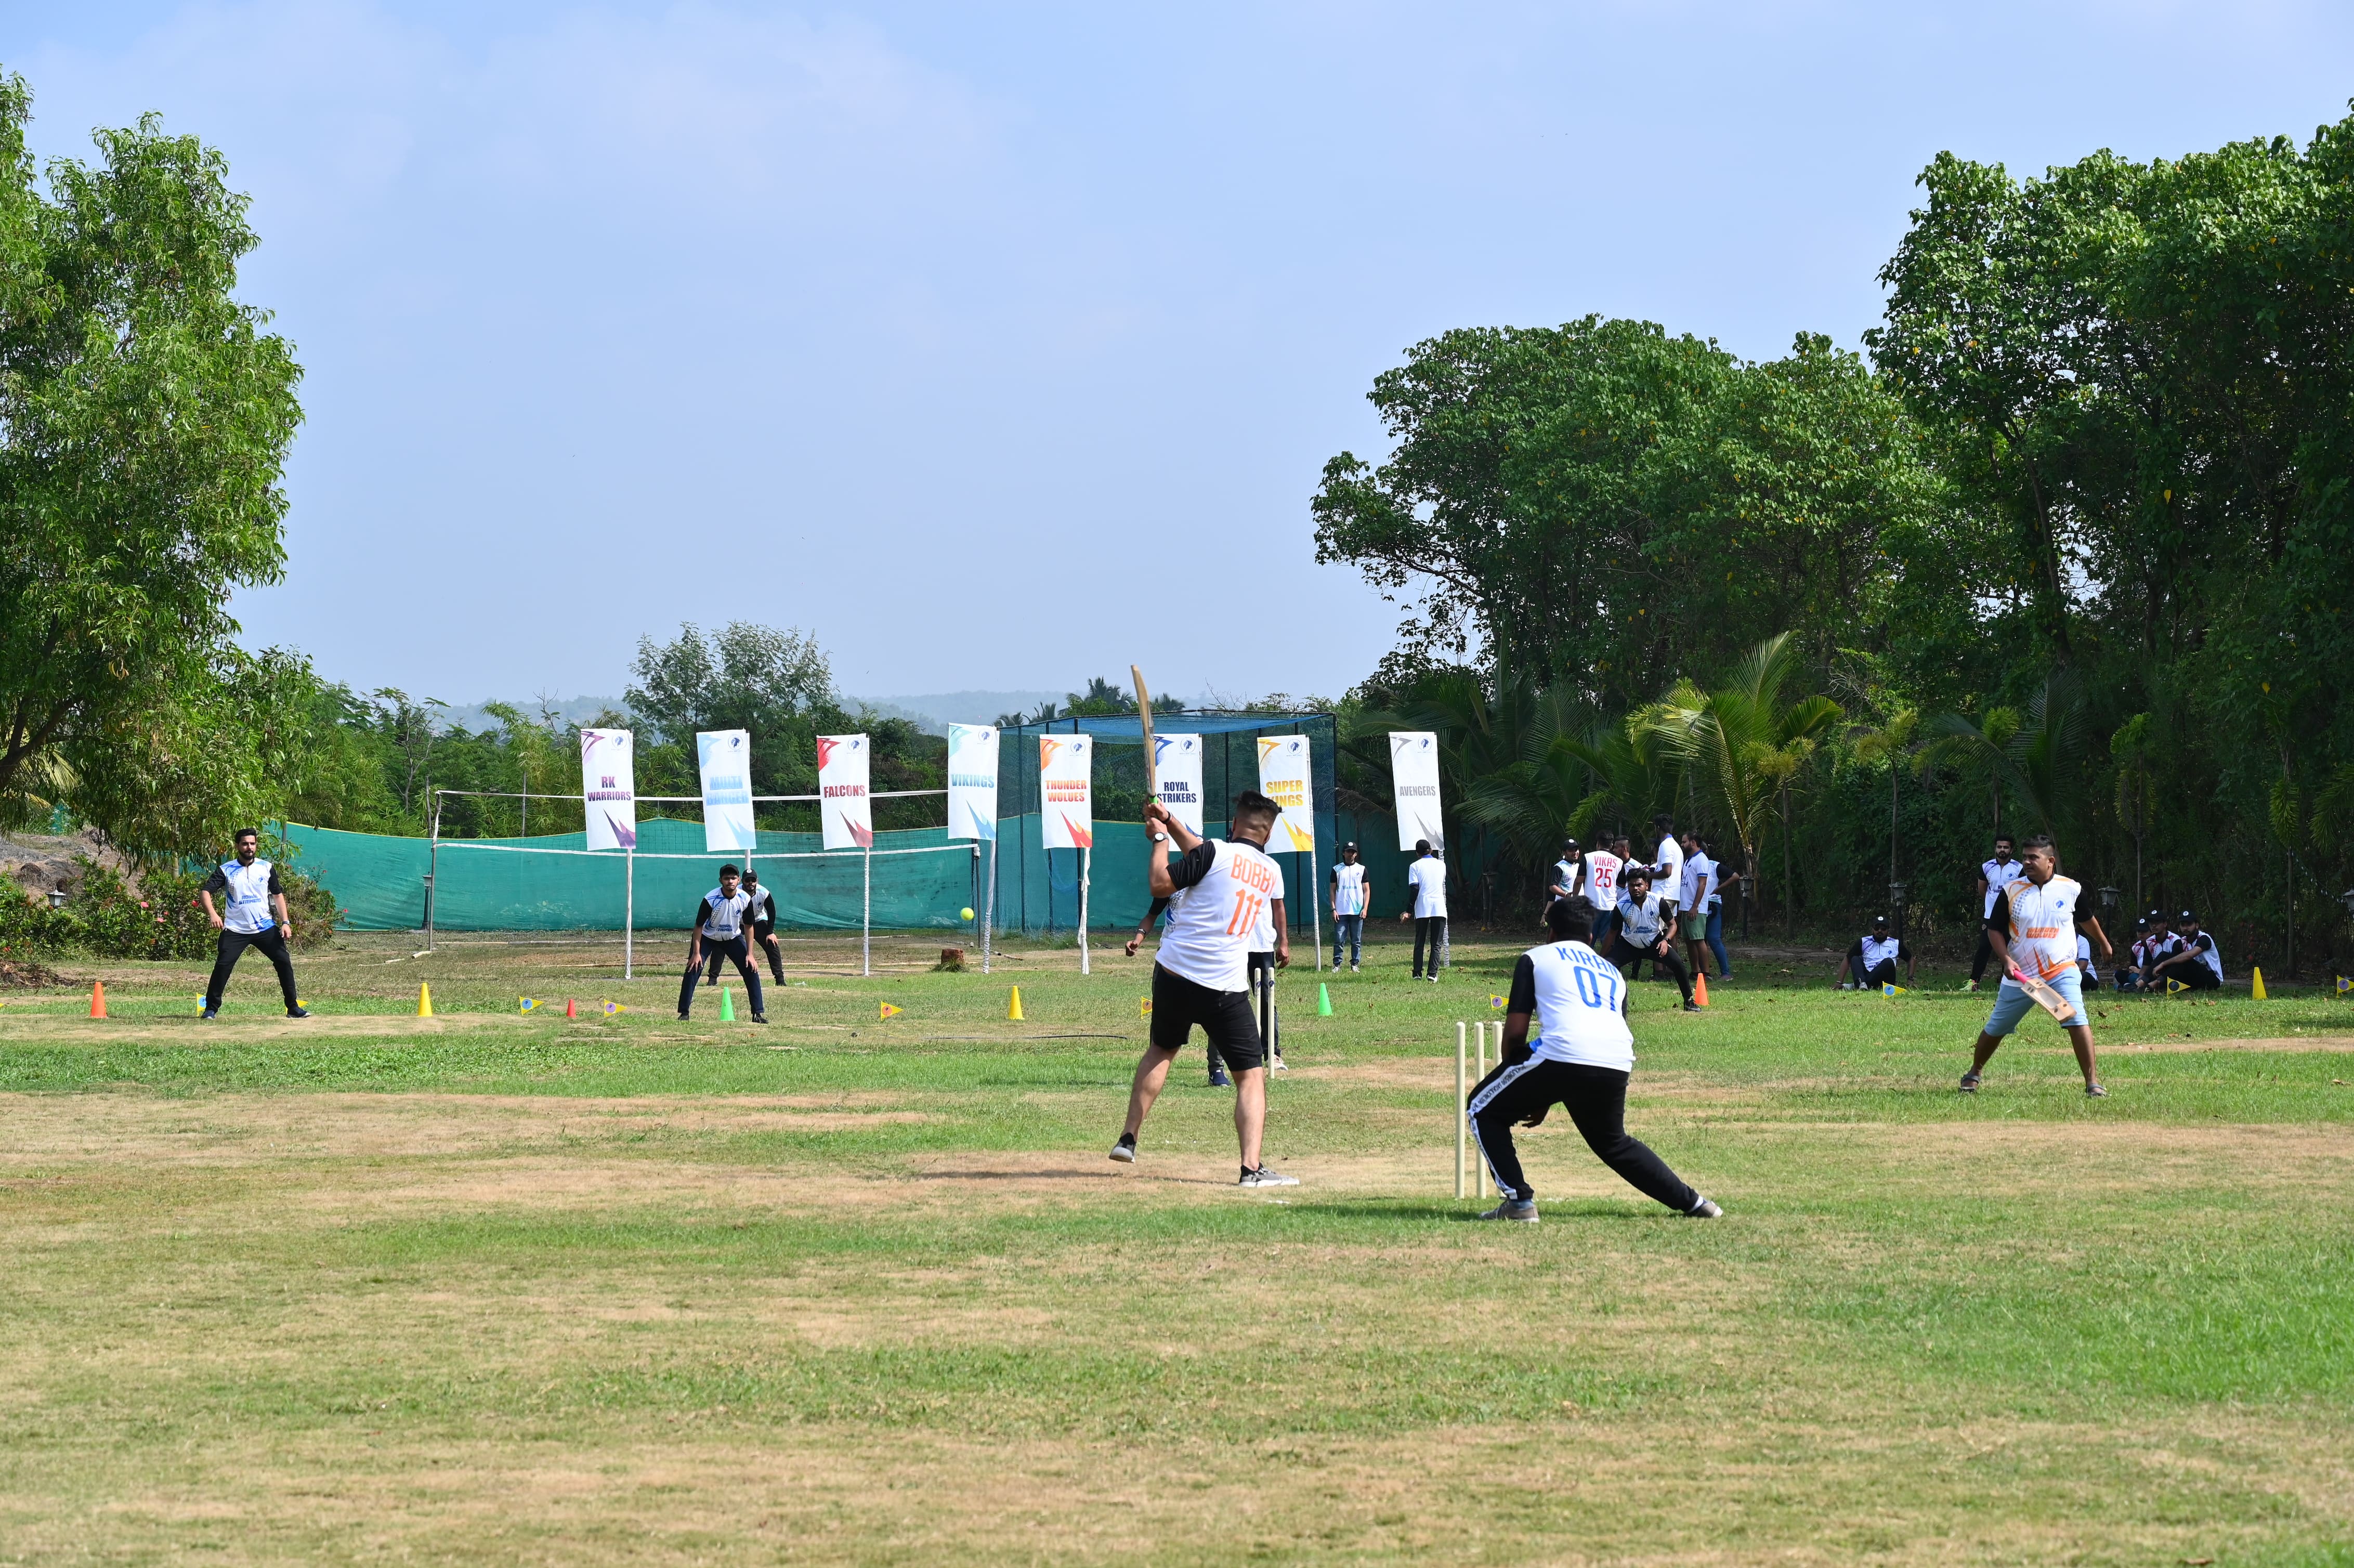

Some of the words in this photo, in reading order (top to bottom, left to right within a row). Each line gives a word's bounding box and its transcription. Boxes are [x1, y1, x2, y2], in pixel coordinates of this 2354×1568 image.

[601, 776, 616, 788] RK
[951, 774, 995, 788] VIKINGS
[1045, 780, 1087, 790] THUNDER
[1164, 781, 1189, 792] ROYAL
[1266, 780, 1303, 794] SUPER
[587, 791, 631, 802] WARRIORS
[823, 785, 866, 799] FALCONS
[1400, 786, 1436, 796] AVENGERS
[1157, 793, 1197, 803] STRIKERS
[1267, 794, 1303, 807] INGS
[1594, 856, 1617, 868] VIKAS
[1231, 853, 1277, 897] BOBBY
[1595, 868, 1613, 888] 25
[1226, 888, 1262, 939] 111
[1555, 946, 1619, 980] KIRAN
[1573, 965, 1616, 1012] 07
